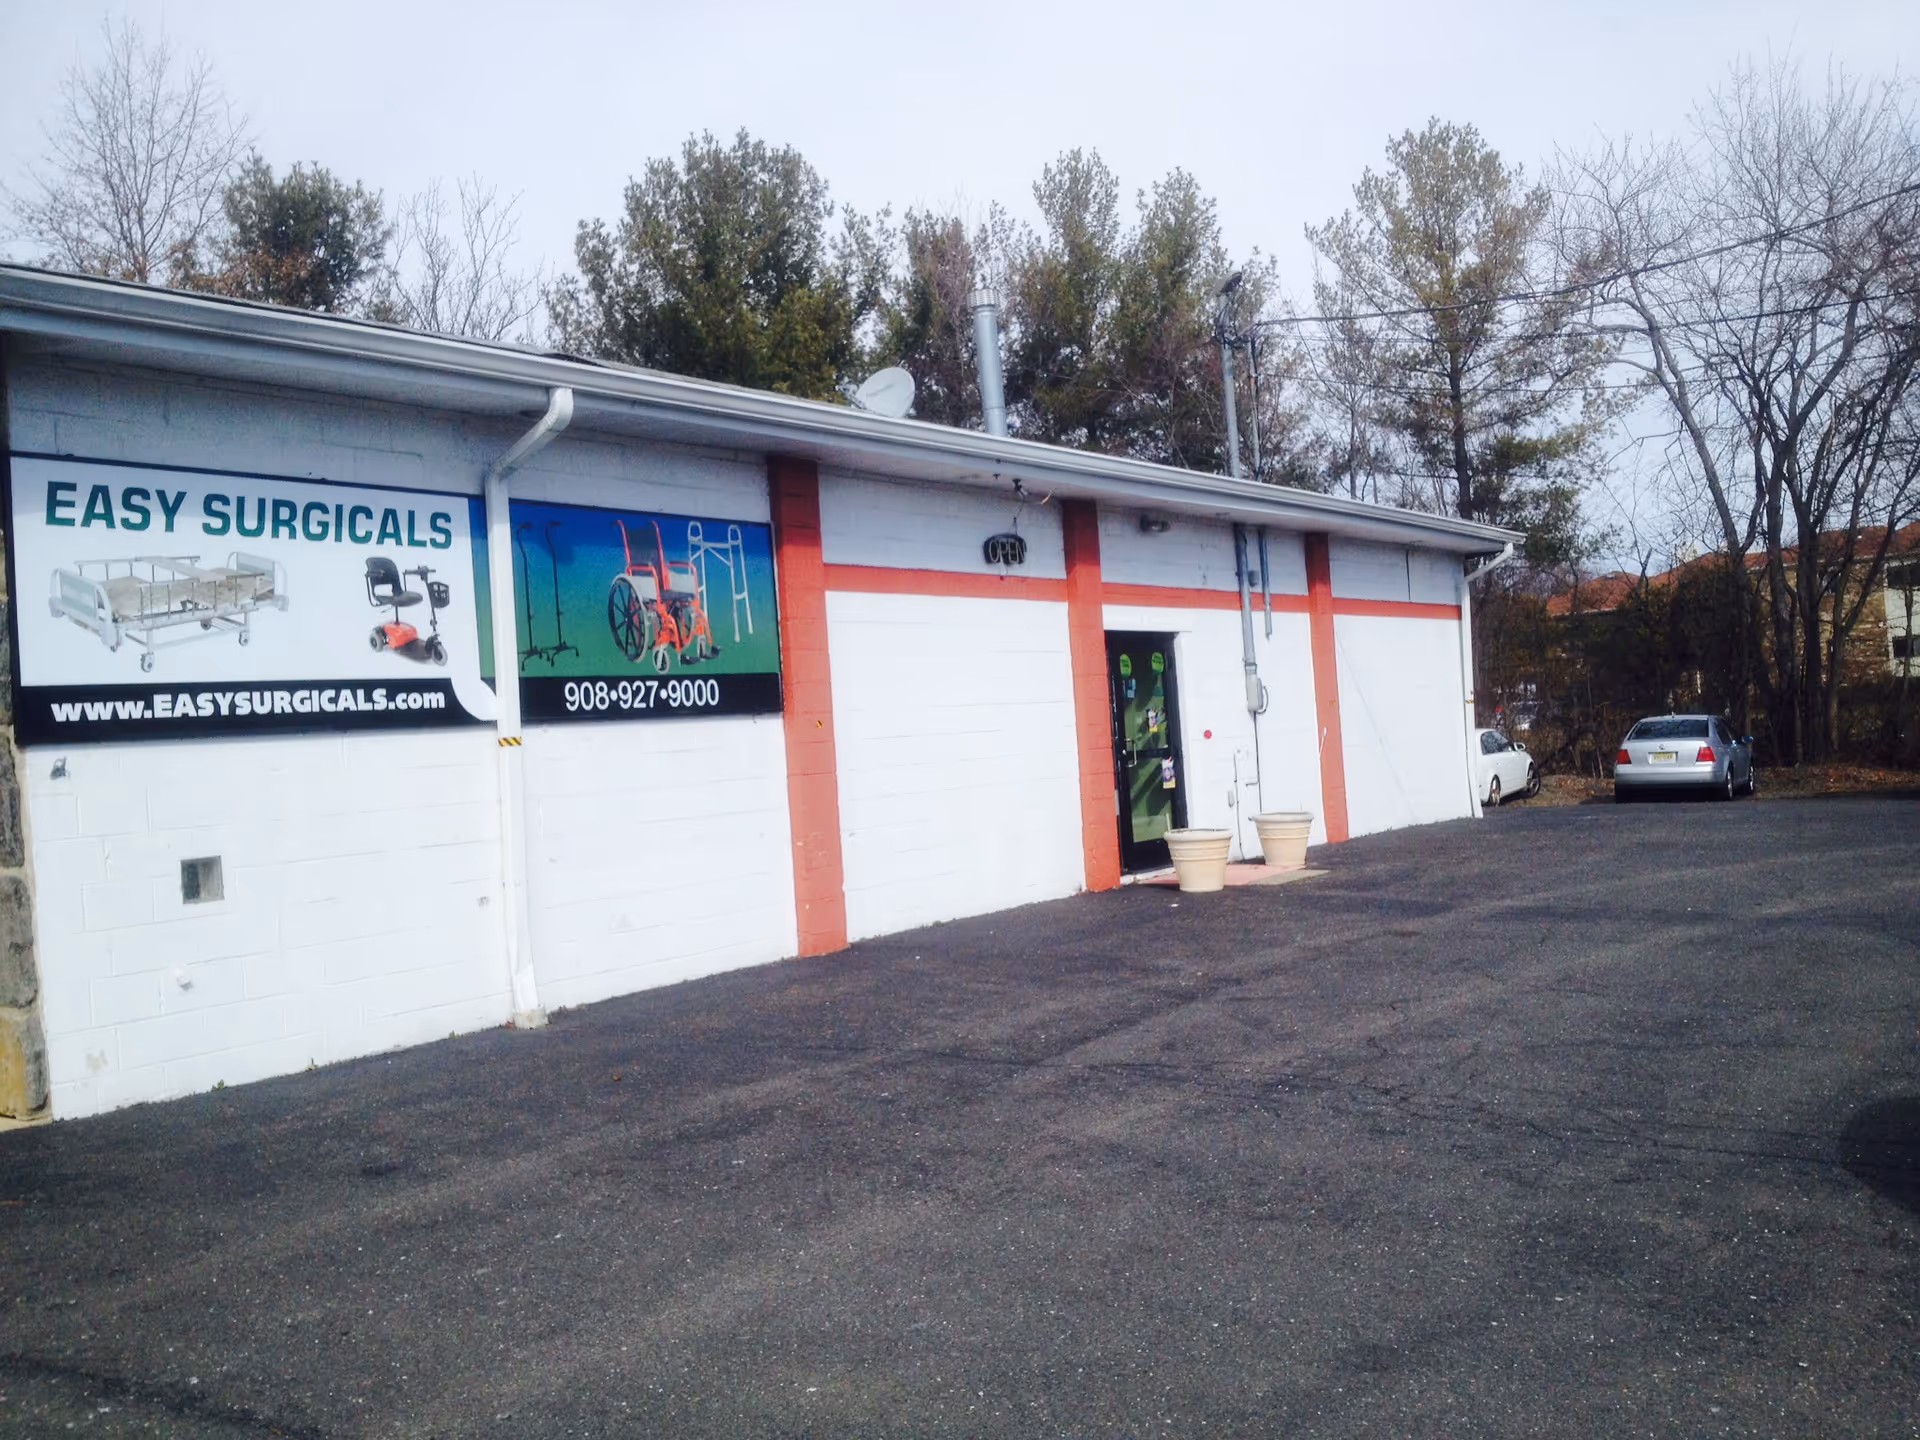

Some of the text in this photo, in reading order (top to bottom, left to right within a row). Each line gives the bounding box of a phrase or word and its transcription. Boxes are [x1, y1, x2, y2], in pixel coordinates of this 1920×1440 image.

[46, 481, 452, 549] EASY SURGICALS
[989, 538, 1025, 563] OPEN
[50, 688, 446, 722] www.EASYSURGICALS.com
